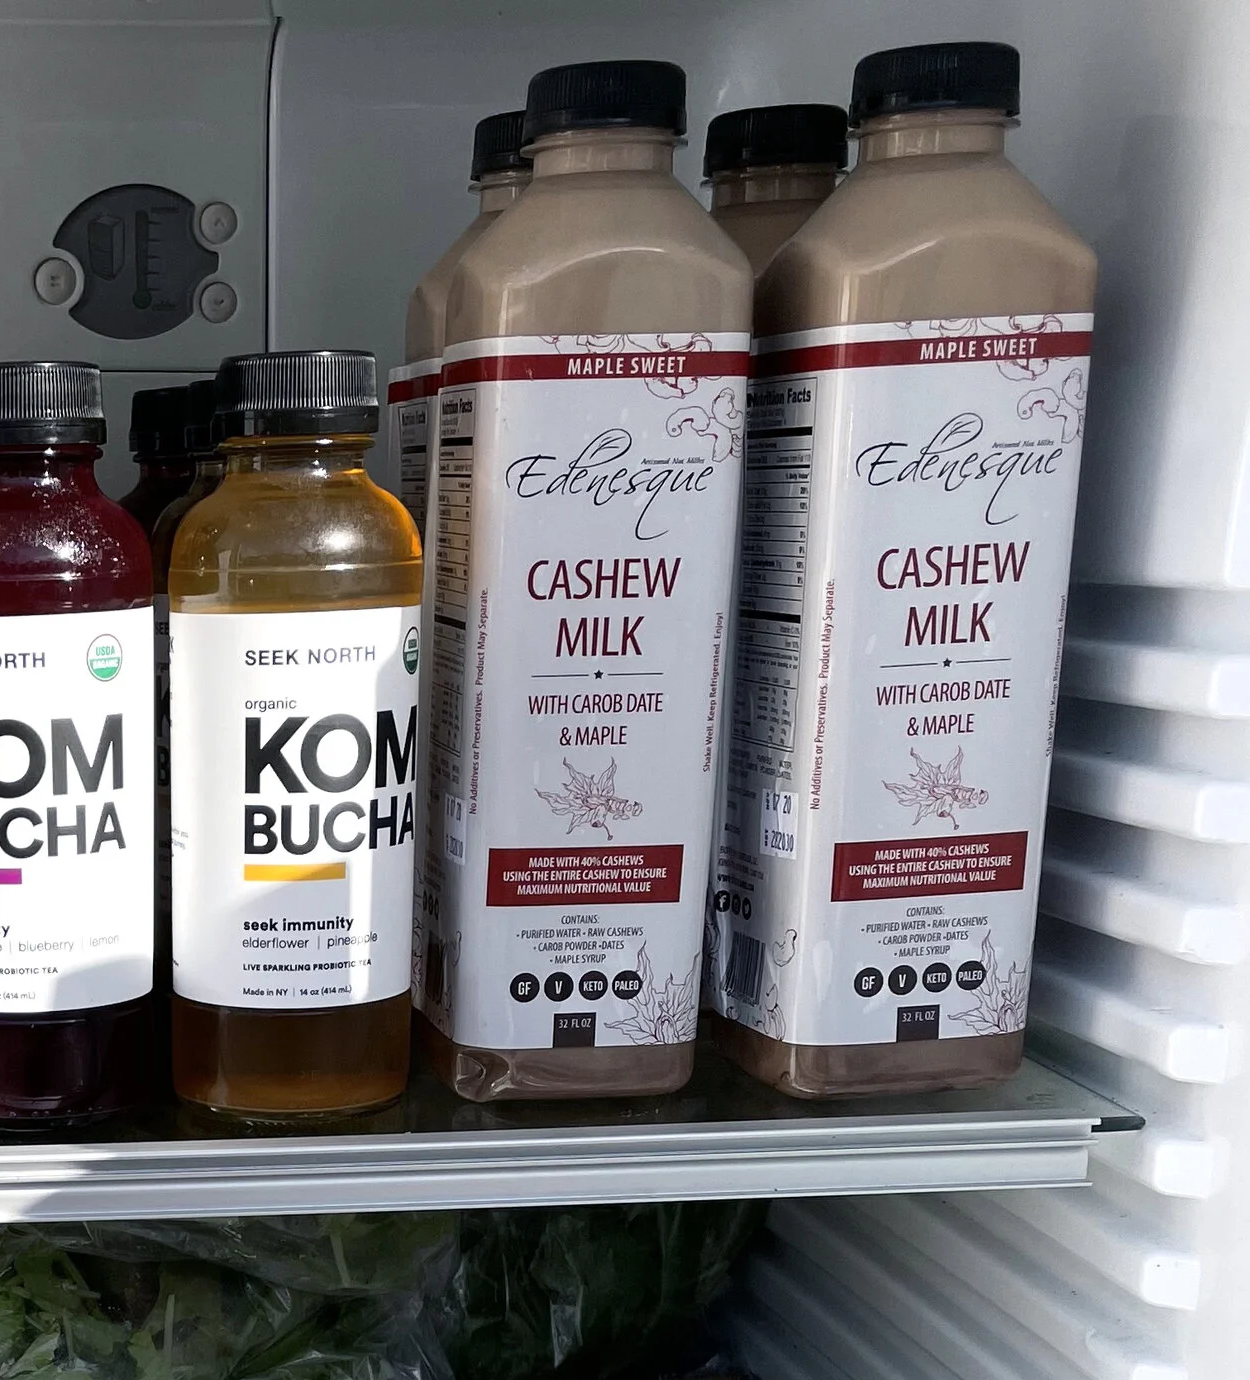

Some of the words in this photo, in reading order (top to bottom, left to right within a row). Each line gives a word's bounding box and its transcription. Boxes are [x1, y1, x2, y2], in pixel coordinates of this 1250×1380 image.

[920, 341, 977, 361] MAPLE
[982, 338, 1038, 358] SWEET
[568, 358, 624, 375] MAPLE
[630, 356, 686, 373] SWEET
[855, 412, 1063, 526] Edenesque
[505, 428, 714, 541] Edenesque
[876, 541, 1030, 590] CASHEW
[527, 558, 681, 601] CASHEW
[904, 601, 993, 648] MILK
[556, 616, 644, 658] MILK
[96, 646, 115, 656] USDA
[245, 649, 299, 666] SEEK
[308, 646, 375, 664] NORTH
[877, 685, 916, 706] WITH
[920, 681, 970, 703] CAROB
[975, 679, 1011, 700] DATE
[245, 697, 297, 712] organic
[529, 695, 568, 714] WITH
[572, 694, 622, 713] CAROB
[627, 693, 663, 712] DATE
[907, 717, 919, 736] &
[923, 714, 974, 735] MAPLE
[560, 727, 571, 746] &
[575, 726, 627, 745] MAPLE
[244, 705, 416, 794] KOM
[244, 792, 414, 855] BUCHA
[529, 857, 554, 868] MADE
[556, 857, 579, 867] WITH
[581, 857, 600, 867] 40%
[602, 855, 643, 866] CASHEWS
[503, 871, 530, 881] USING
[532, 871, 548, 881] THE
[550, 870, 581, 880] ENTIRE
[583, 869, 619, 880] CASHEW
[621, 869, 632, 879] TO
[633, 868, 667, 879] ENSURE
[517, 883, 563, 895] MAXIMUM
[564, 882, 622, 894] NUTRITIONAL
[624, 882, 651, 892] VALUE
[244, 918, 278, 931] seek
[283, 916, 354, 931] immunity
[561, 915, 599, 924] CONTAINS:
[19, 941, 74, 952] blueberry
[90, 935, 119, 947] lemon
[243, 937, 309, 949] elderflower
[327, 931, 378, 948] pineapple
[313, 961, 355, 971] PROBIOTIC
[321, 987, 336, 996] (414
[518, 981, 531, 996] GF
[555, 980, 563, 994] V
[583, 981, 603, 992] KETO
[615, 980, 639, 991] PALEO
[559, 1019, 568, 1028] 32
[572, 1019, 579, 1028] FL
[581, 1018, 591, 1028] OZ
